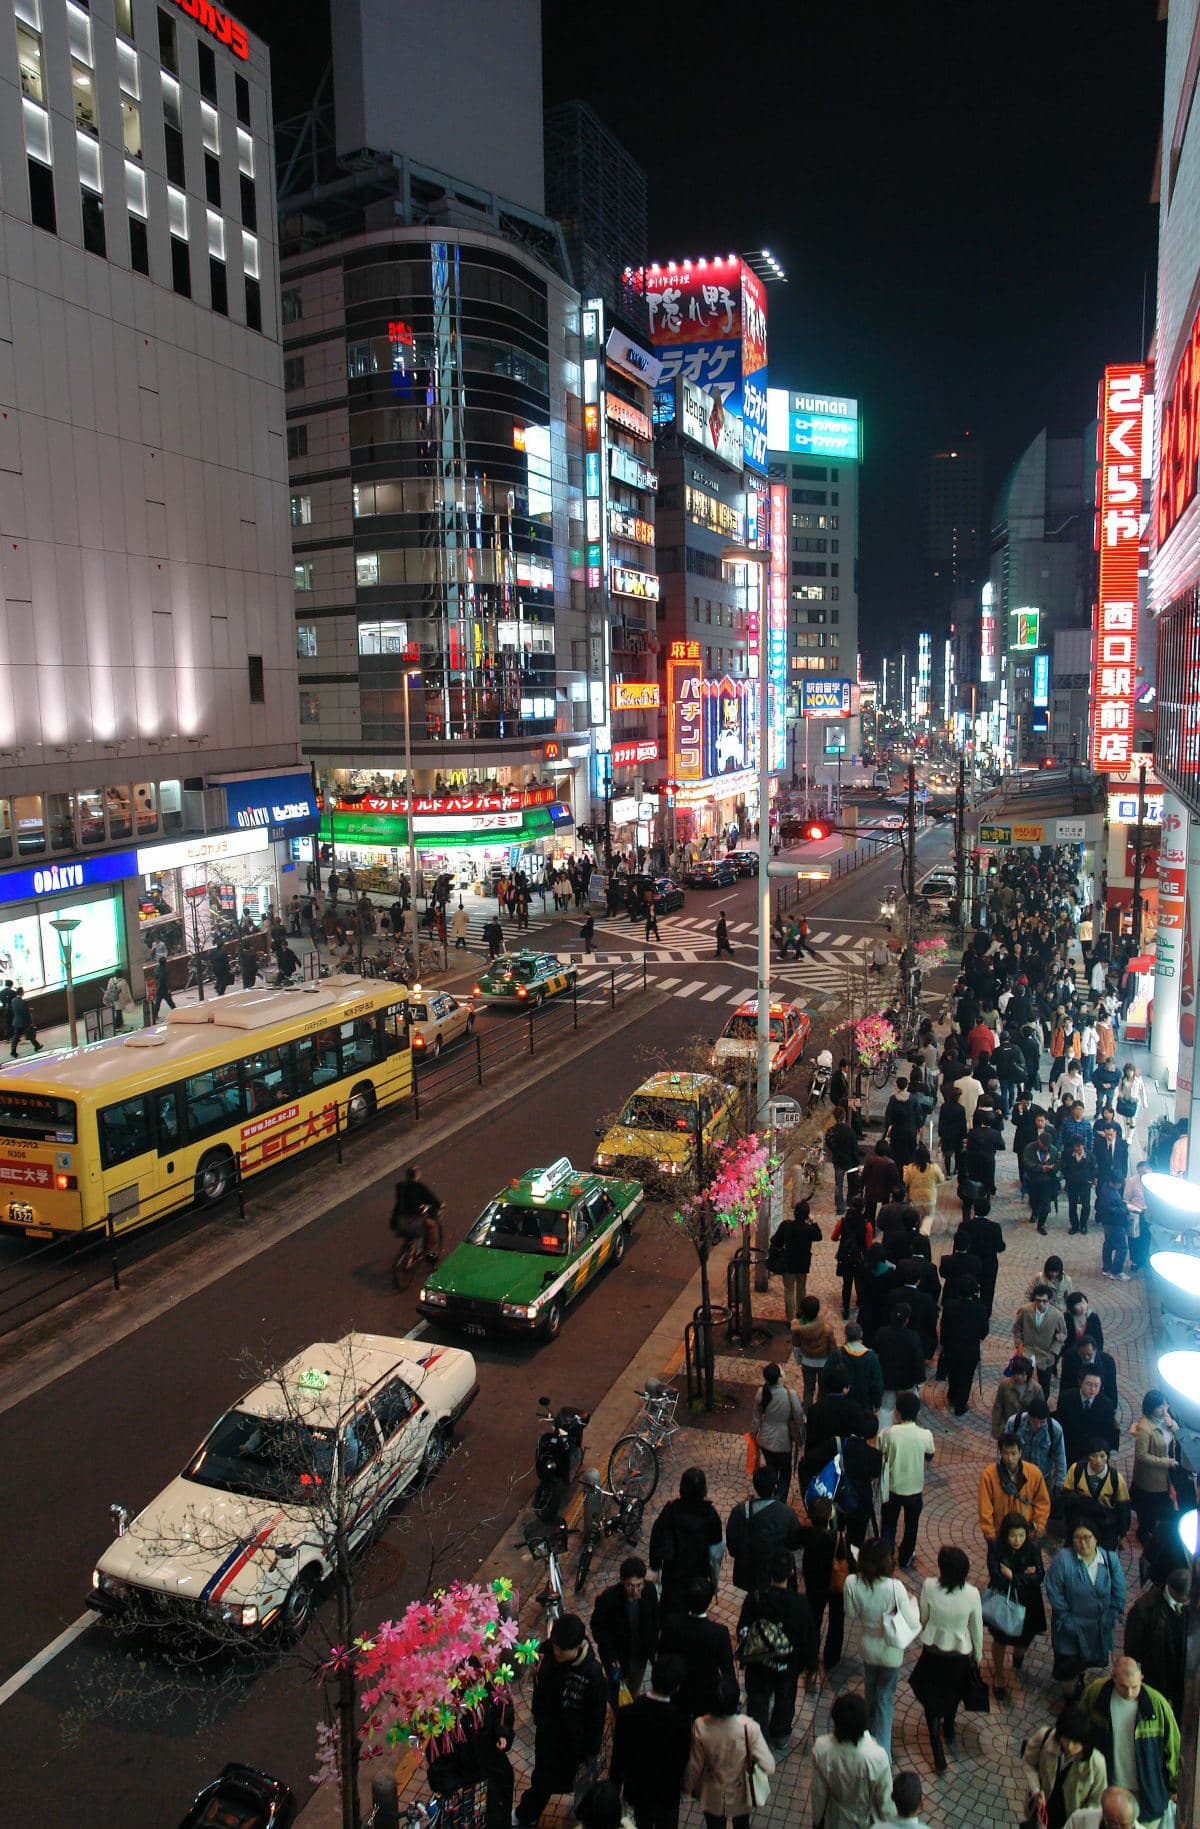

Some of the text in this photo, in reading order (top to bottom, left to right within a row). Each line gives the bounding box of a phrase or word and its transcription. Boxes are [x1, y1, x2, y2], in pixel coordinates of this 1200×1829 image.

[645, 284, 736, 334] 隠れ野
[659, 345, 736, 384] ラオケ
[684, 386, 707, 428] Tengu
[795, 397, 848, 415] Human
[1099, 373, 1142, 761] さくらや 西口駅前店
[671, 641, 700, 658] 麻雀
[806, 682, 841, 693] 駅前留学
[806, 694, 840, 707] NOVA
[680, 677, 701, 767] パチンコ
[237, 806, 270, 826] ODAKYU
[472, 815, 518, 828] アメミヤ
[33, 865, 83, 893] ODAKYU
